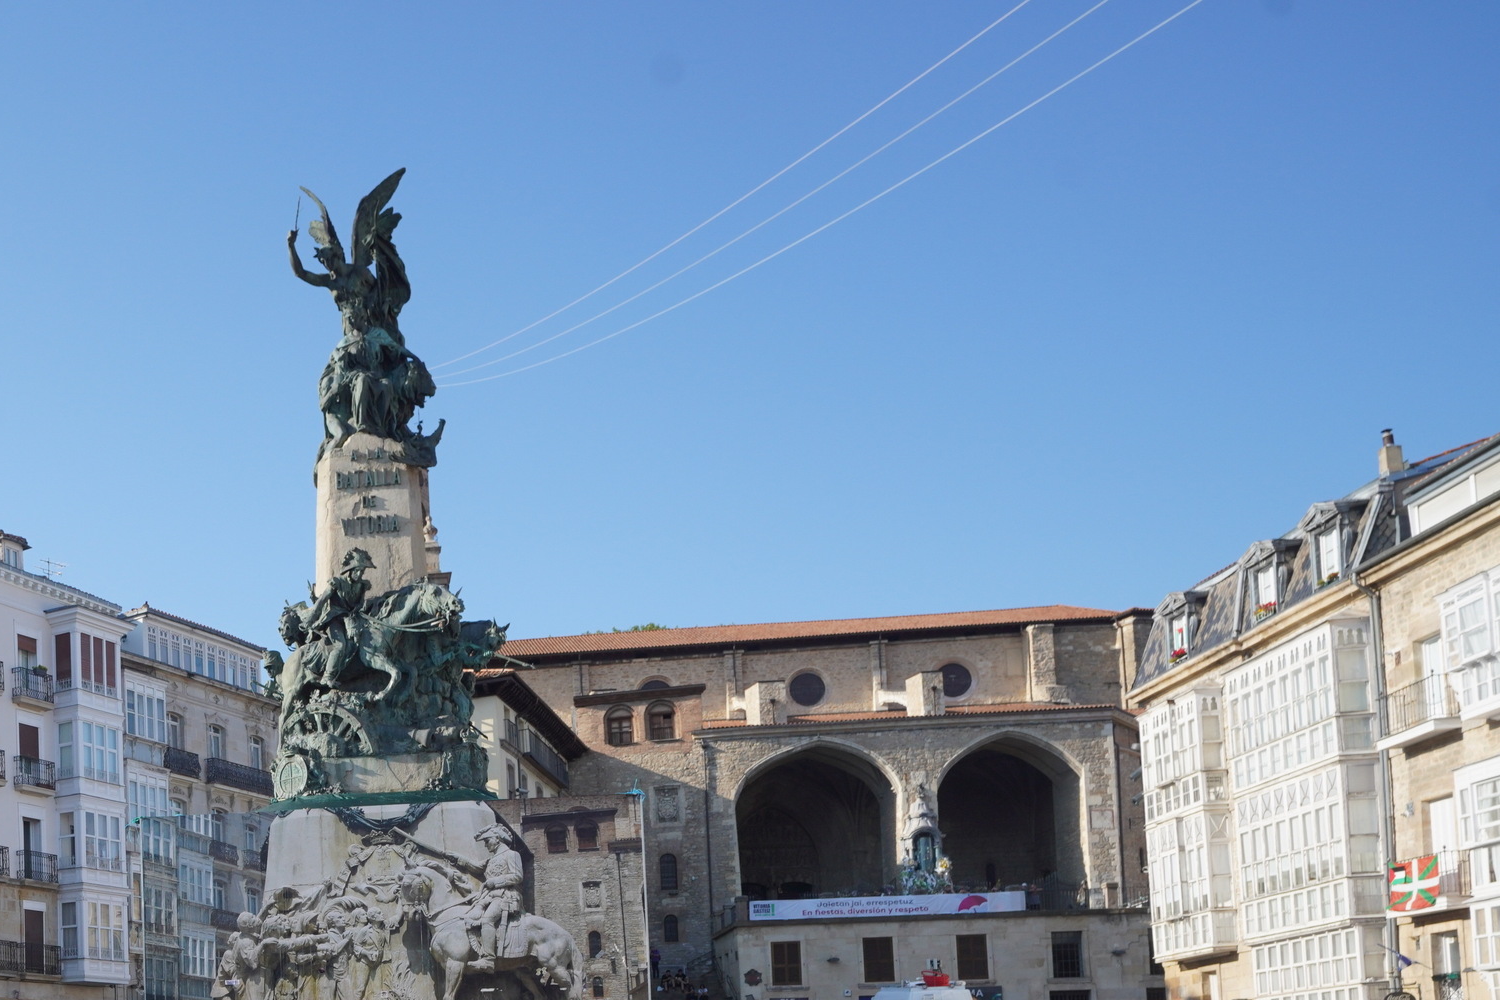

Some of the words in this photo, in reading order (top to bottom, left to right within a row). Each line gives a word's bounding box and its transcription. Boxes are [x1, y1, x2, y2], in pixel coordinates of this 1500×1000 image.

[365, 446, 382, 460] LA
[335, 467, 401, 490] BATALLA
[361, 494, 376, 508] DE
[340, 513, 400, 536] VITORIA
[814, 908, 846, 916] fiestas,
[847, 906, 886, 914] diversión
[895, 905, 929, 914] respeto
